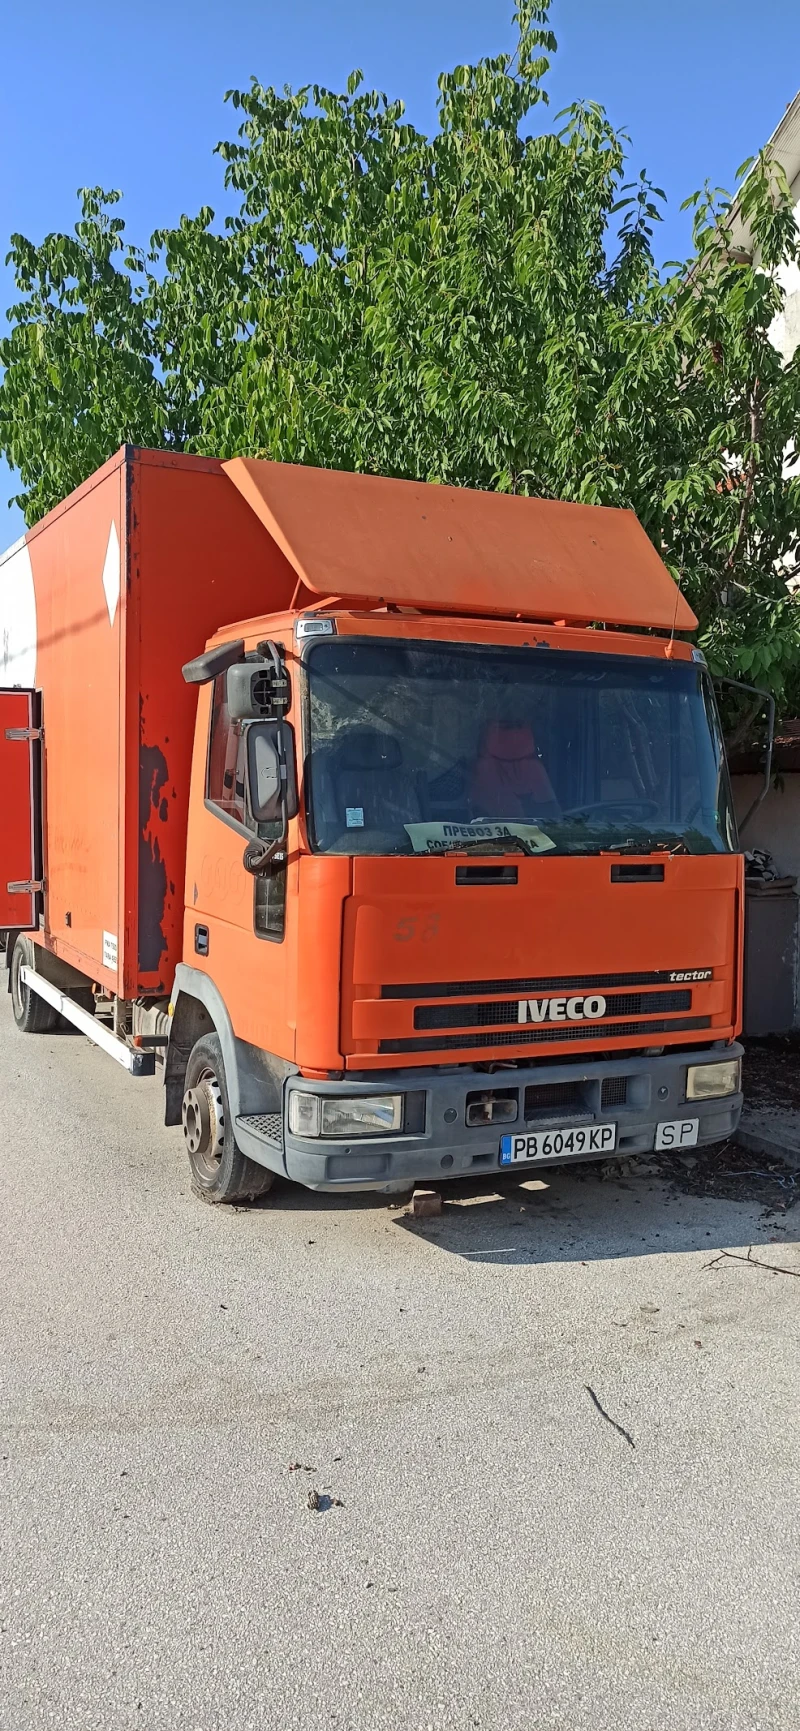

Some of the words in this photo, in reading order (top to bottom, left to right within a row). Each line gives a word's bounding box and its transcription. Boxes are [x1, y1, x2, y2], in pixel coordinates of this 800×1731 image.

[443, 825, 491, 837] ПРЕВОЗ
[495, 825, 511, 836] ЗА
[670, 970, 711, 980] tector
[518, 996, 606, 1022] IVECO
[502, 1152, 511, 1160] BG
[514, 1137, 538, 1159] PB
[542, 1130, 585, 1154] 6049
[590, 1124, 612, 1149] KP
